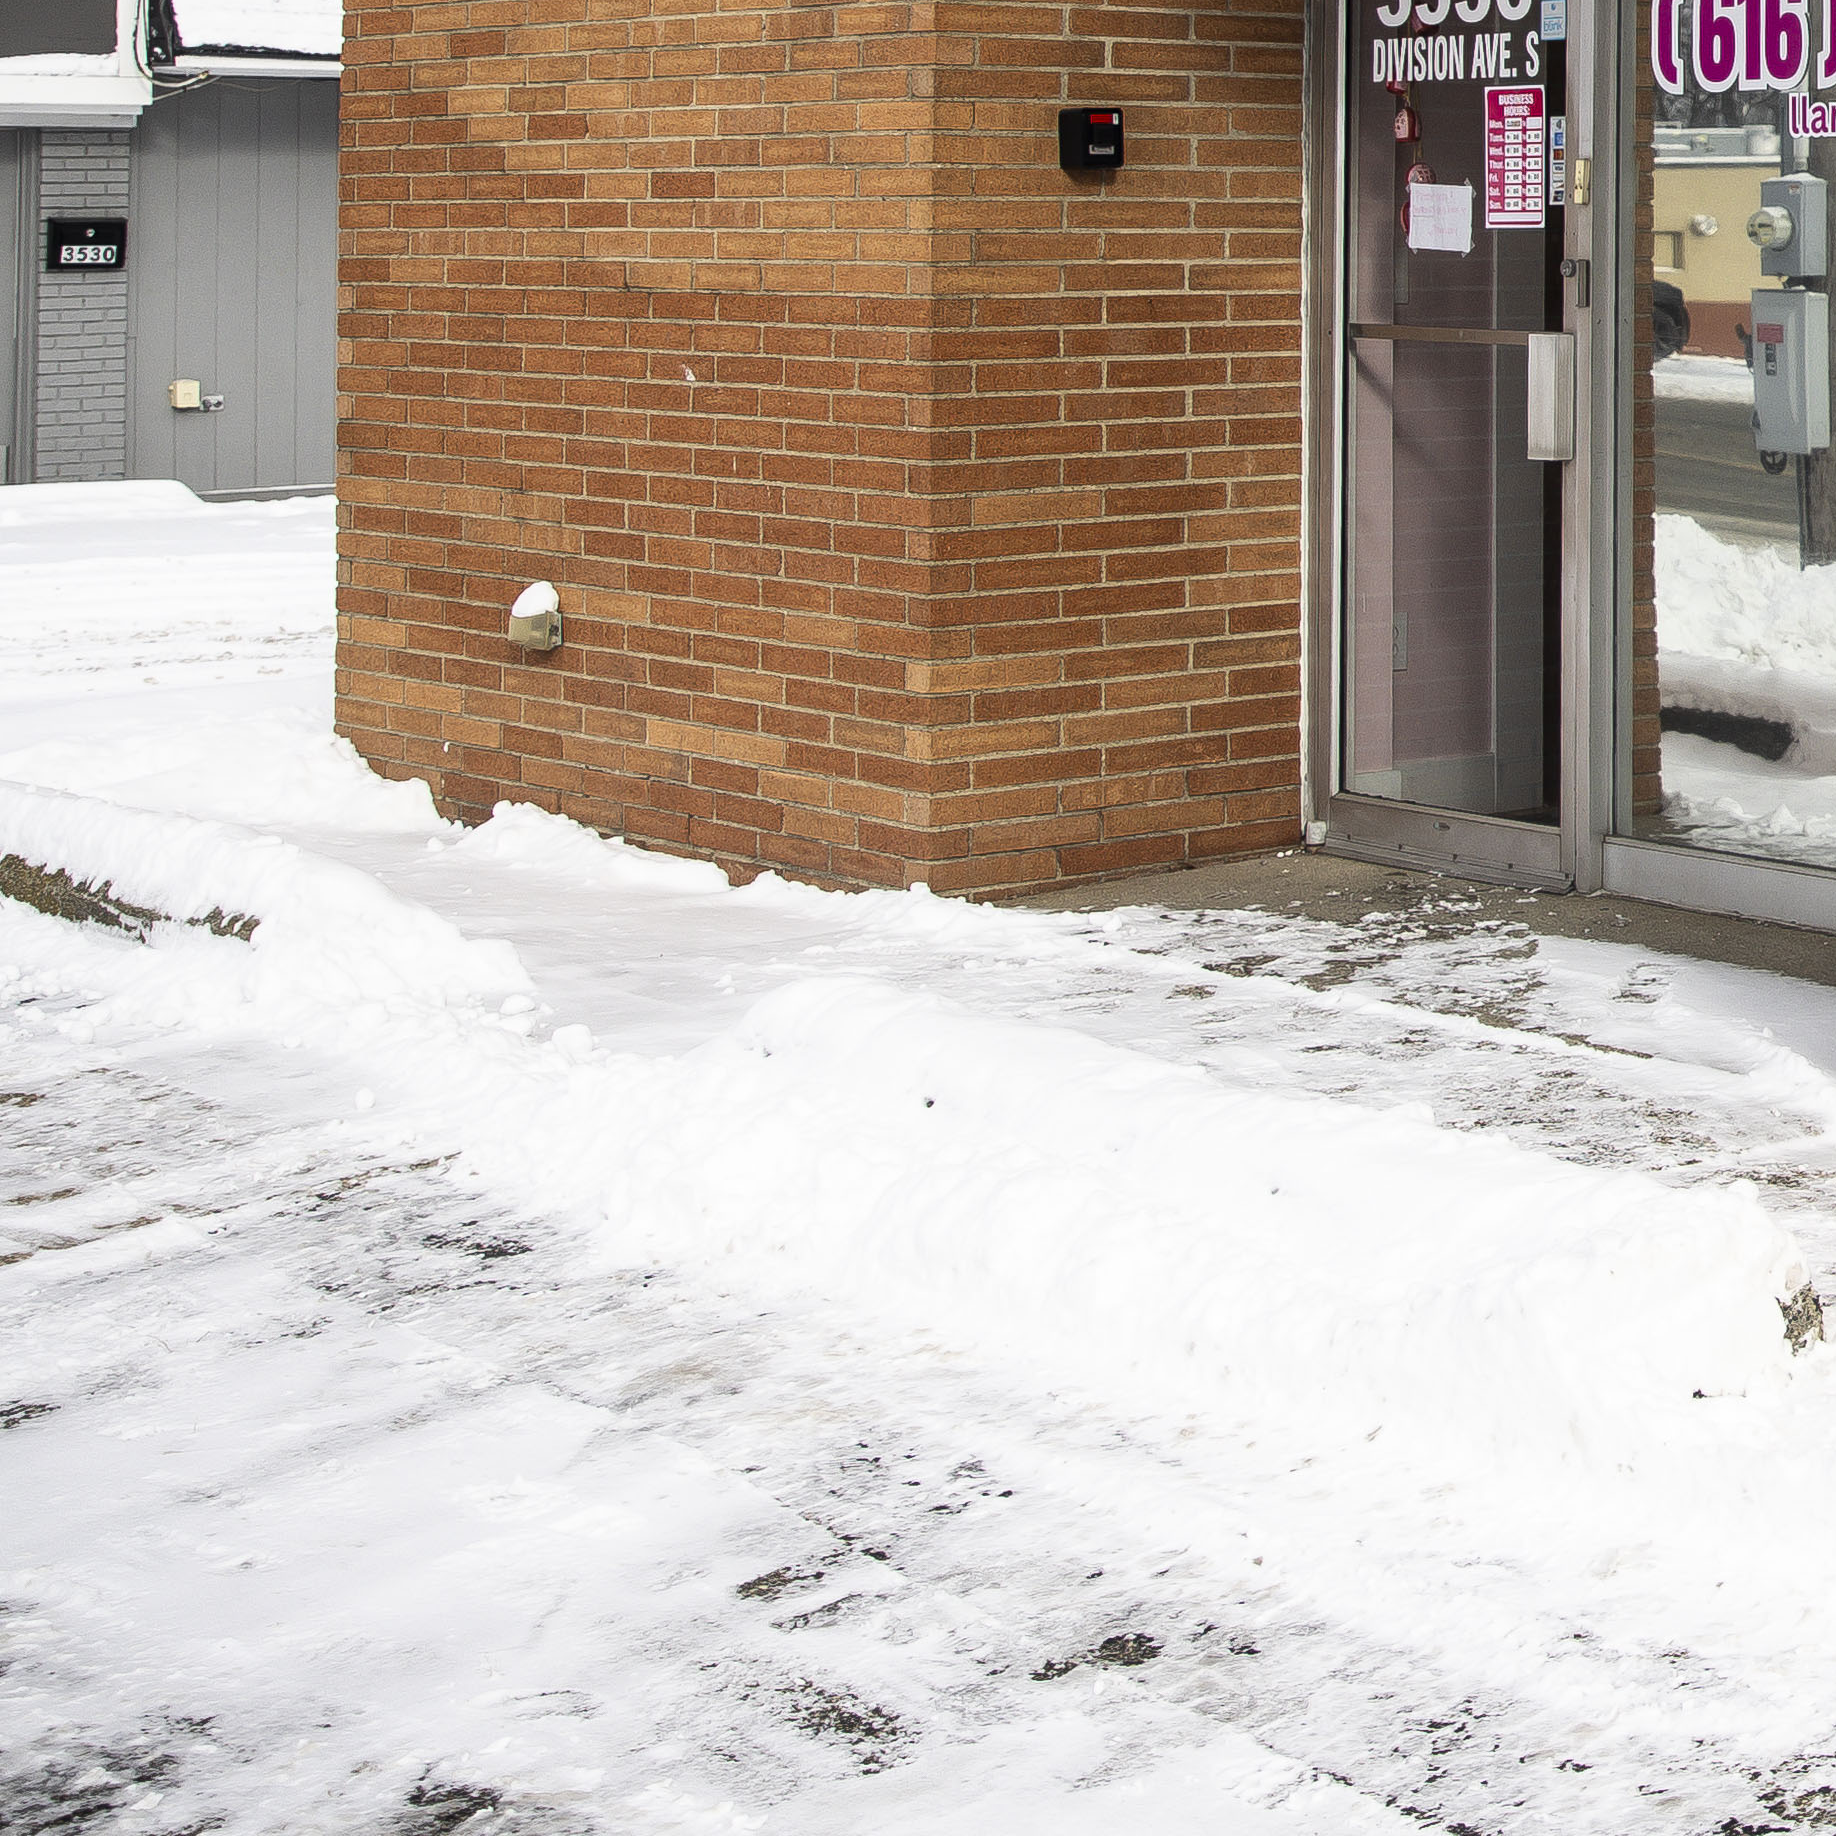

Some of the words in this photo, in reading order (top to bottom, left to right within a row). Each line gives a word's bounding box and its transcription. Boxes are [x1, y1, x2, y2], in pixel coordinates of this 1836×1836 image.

[1372, 35, 1465, 83] DIVISION
[1471, 32, 1518, 79] AVE.
[1525, 30, 1540, 78] S
[63, 246, 115, 262] 3530
